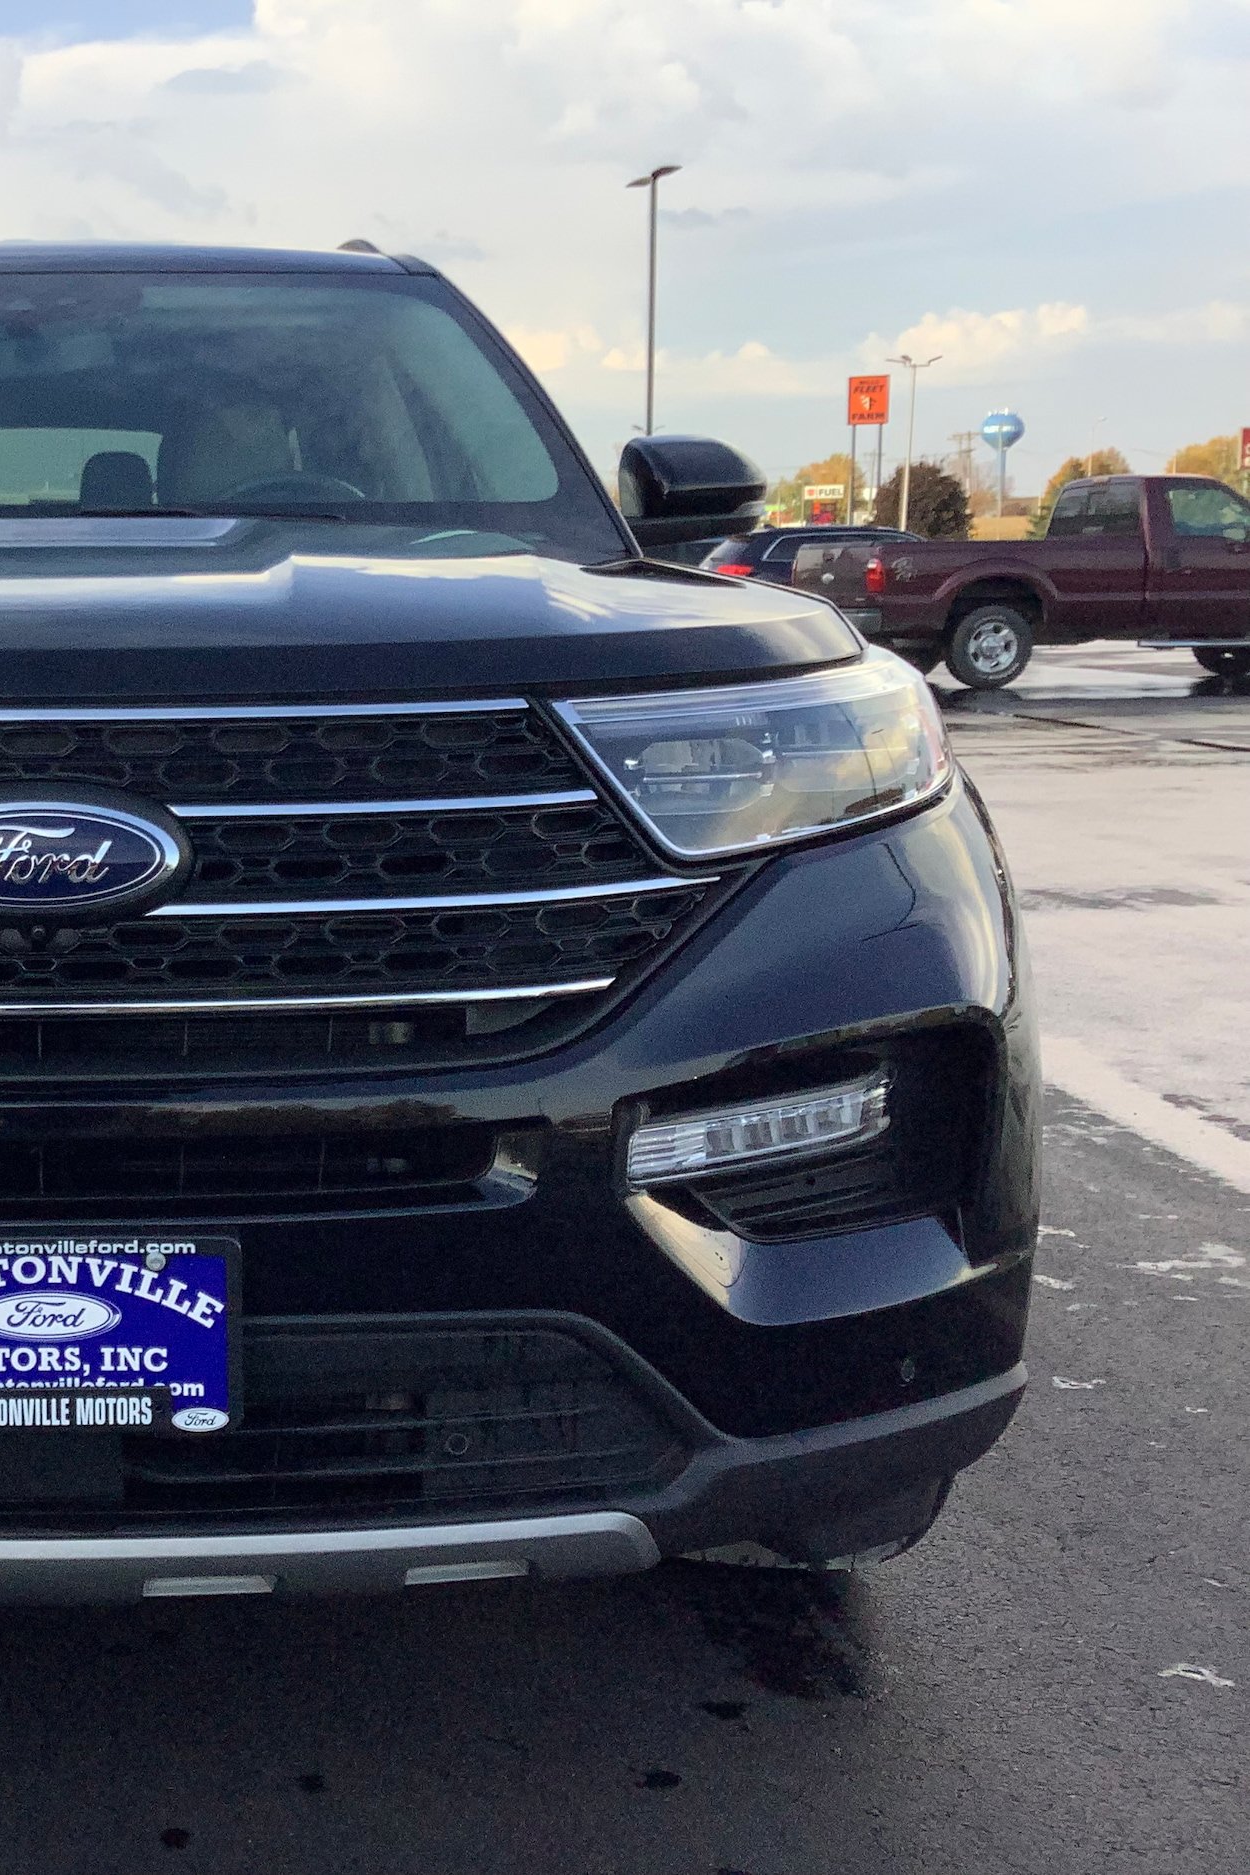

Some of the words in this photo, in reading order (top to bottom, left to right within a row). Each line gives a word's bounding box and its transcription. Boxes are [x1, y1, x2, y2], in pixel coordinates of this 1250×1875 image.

[818, 487, 844, 497] FUEL
[6, 1300, 86, 1328] Ford
[100, 1347, 169, 1373] INC
[75, 1397, 153, 1426] MOTORS
[184, 1412, 217, 1427] Ford
